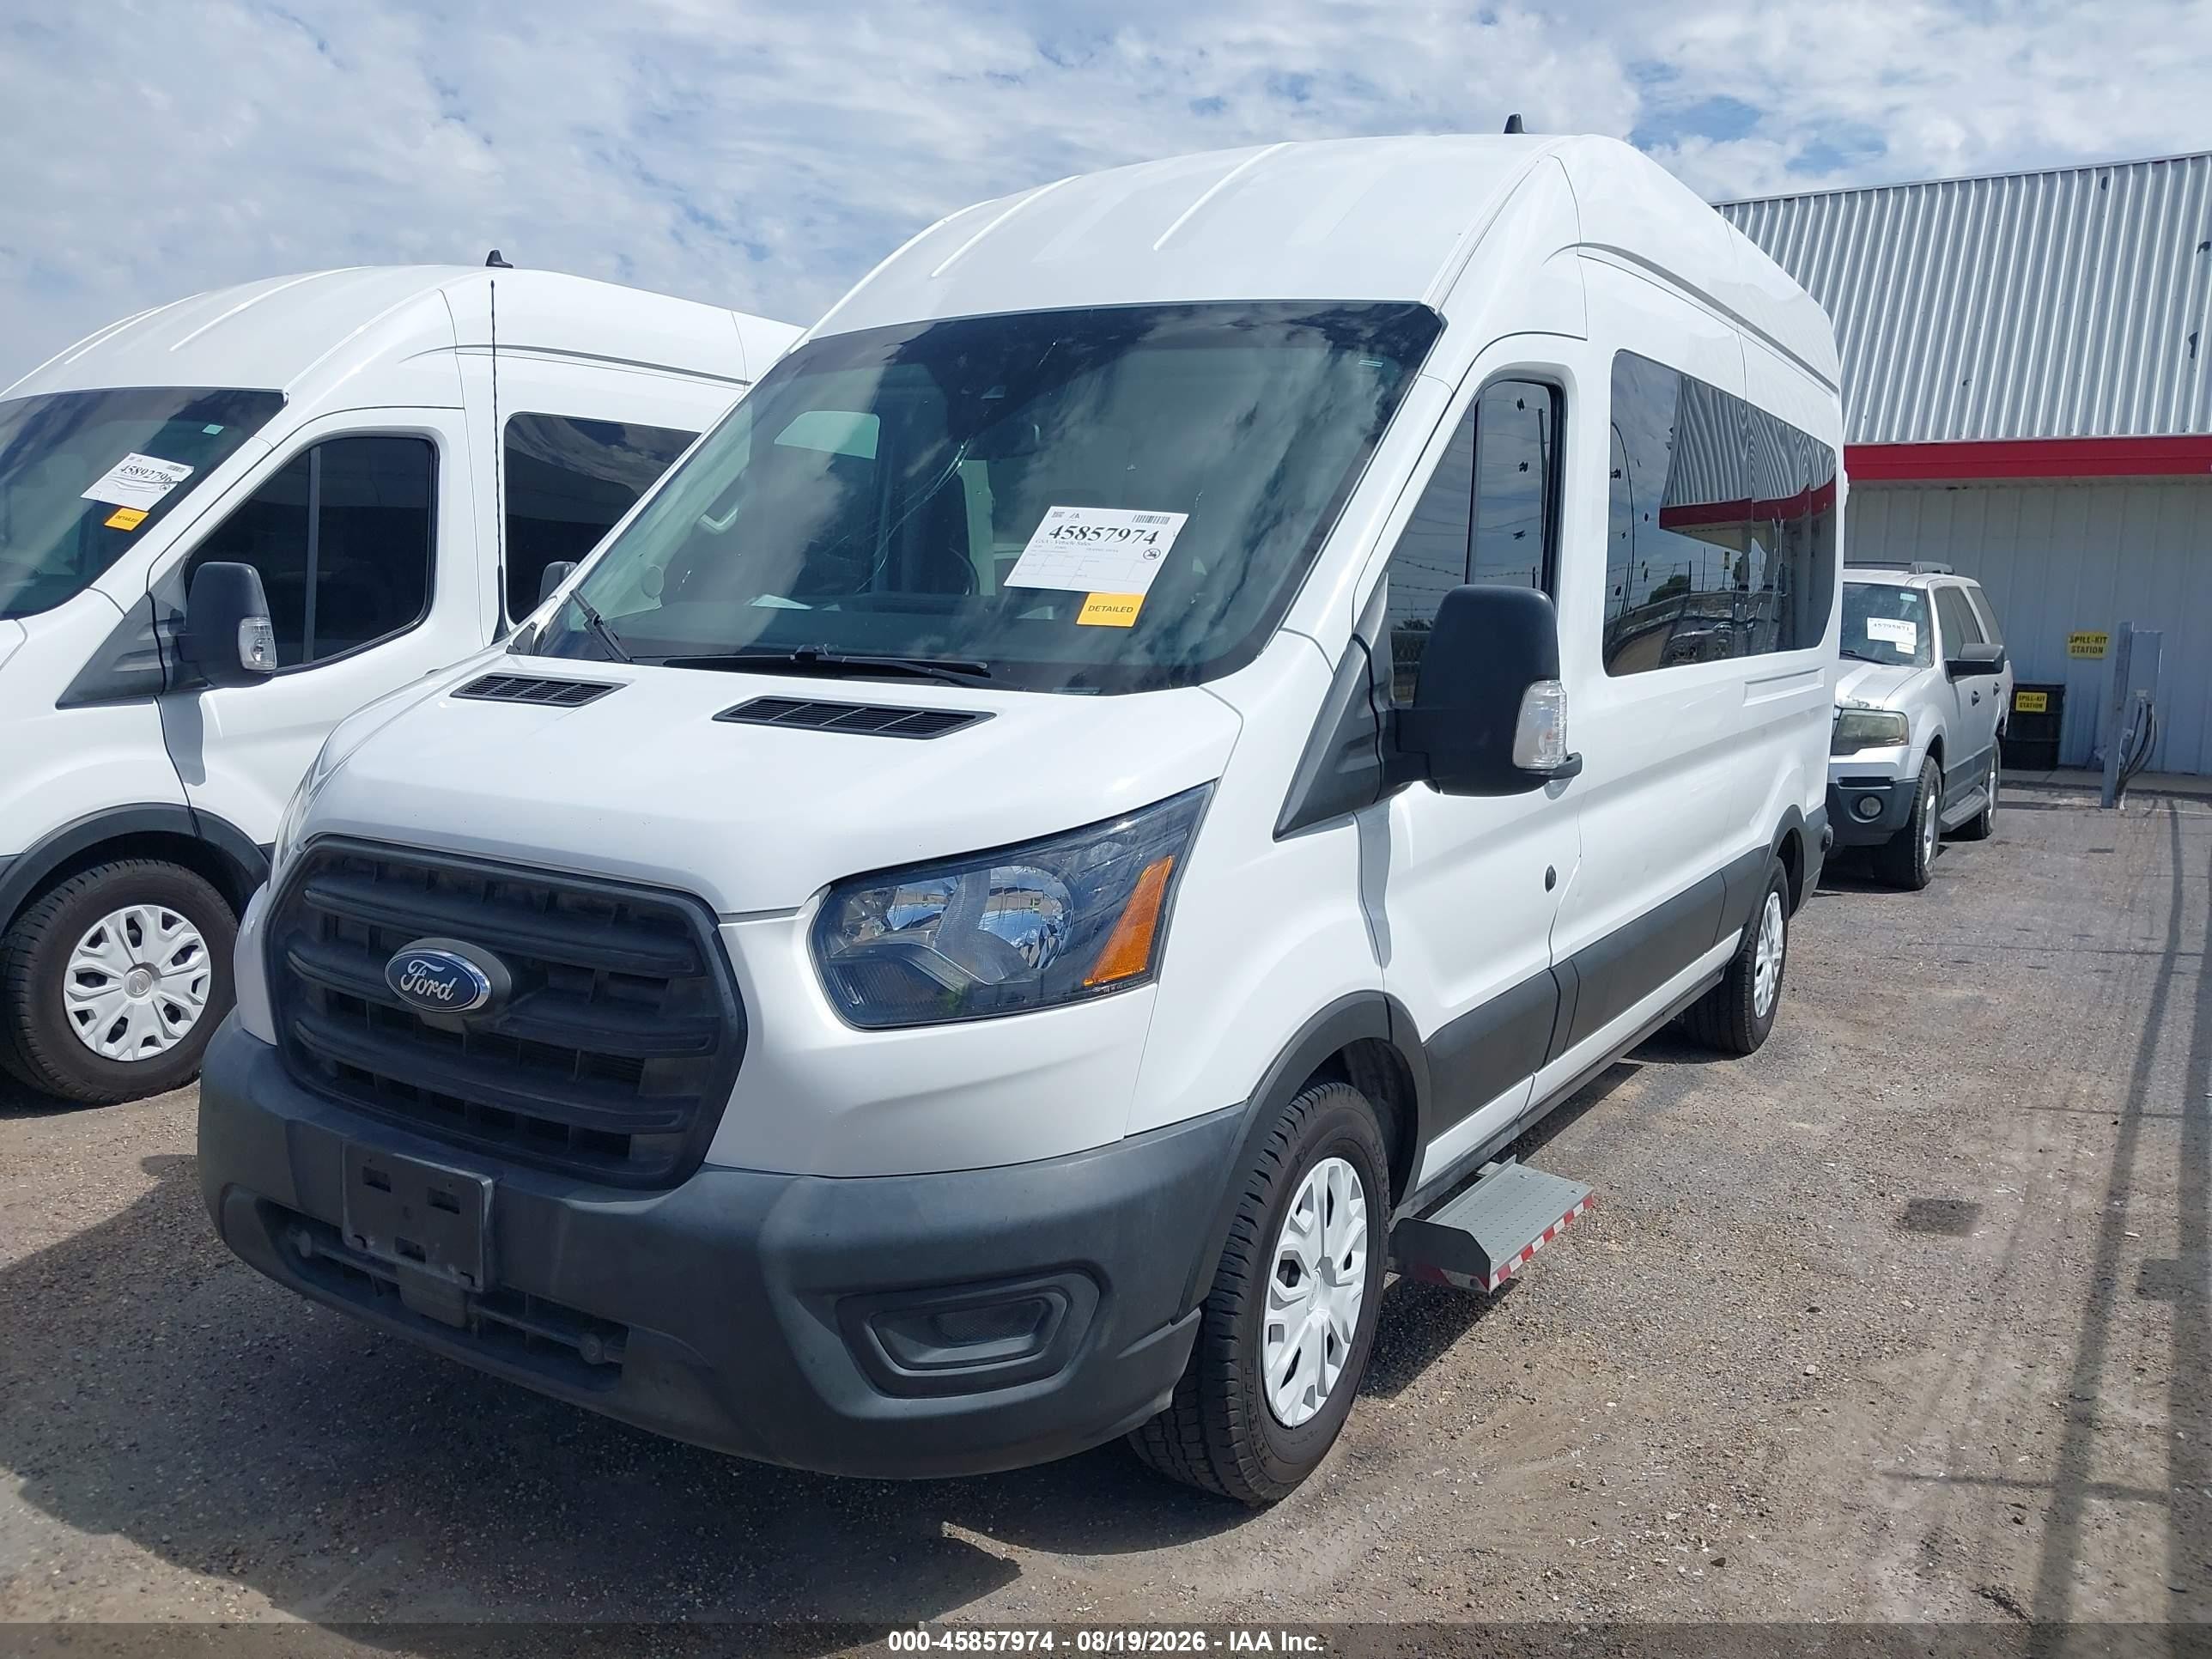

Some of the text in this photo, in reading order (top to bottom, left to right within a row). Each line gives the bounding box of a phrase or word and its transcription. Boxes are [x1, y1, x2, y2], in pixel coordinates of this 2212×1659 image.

[1048, 525, 1160, 544] 45857974
[1087, 605, 1133, 613] DETAILED
[2069, 635, 2108, 644] SPILL-KIT
[2070, 645, 2104, 653] STATION
[400, 959, 458, 1000] Ford
